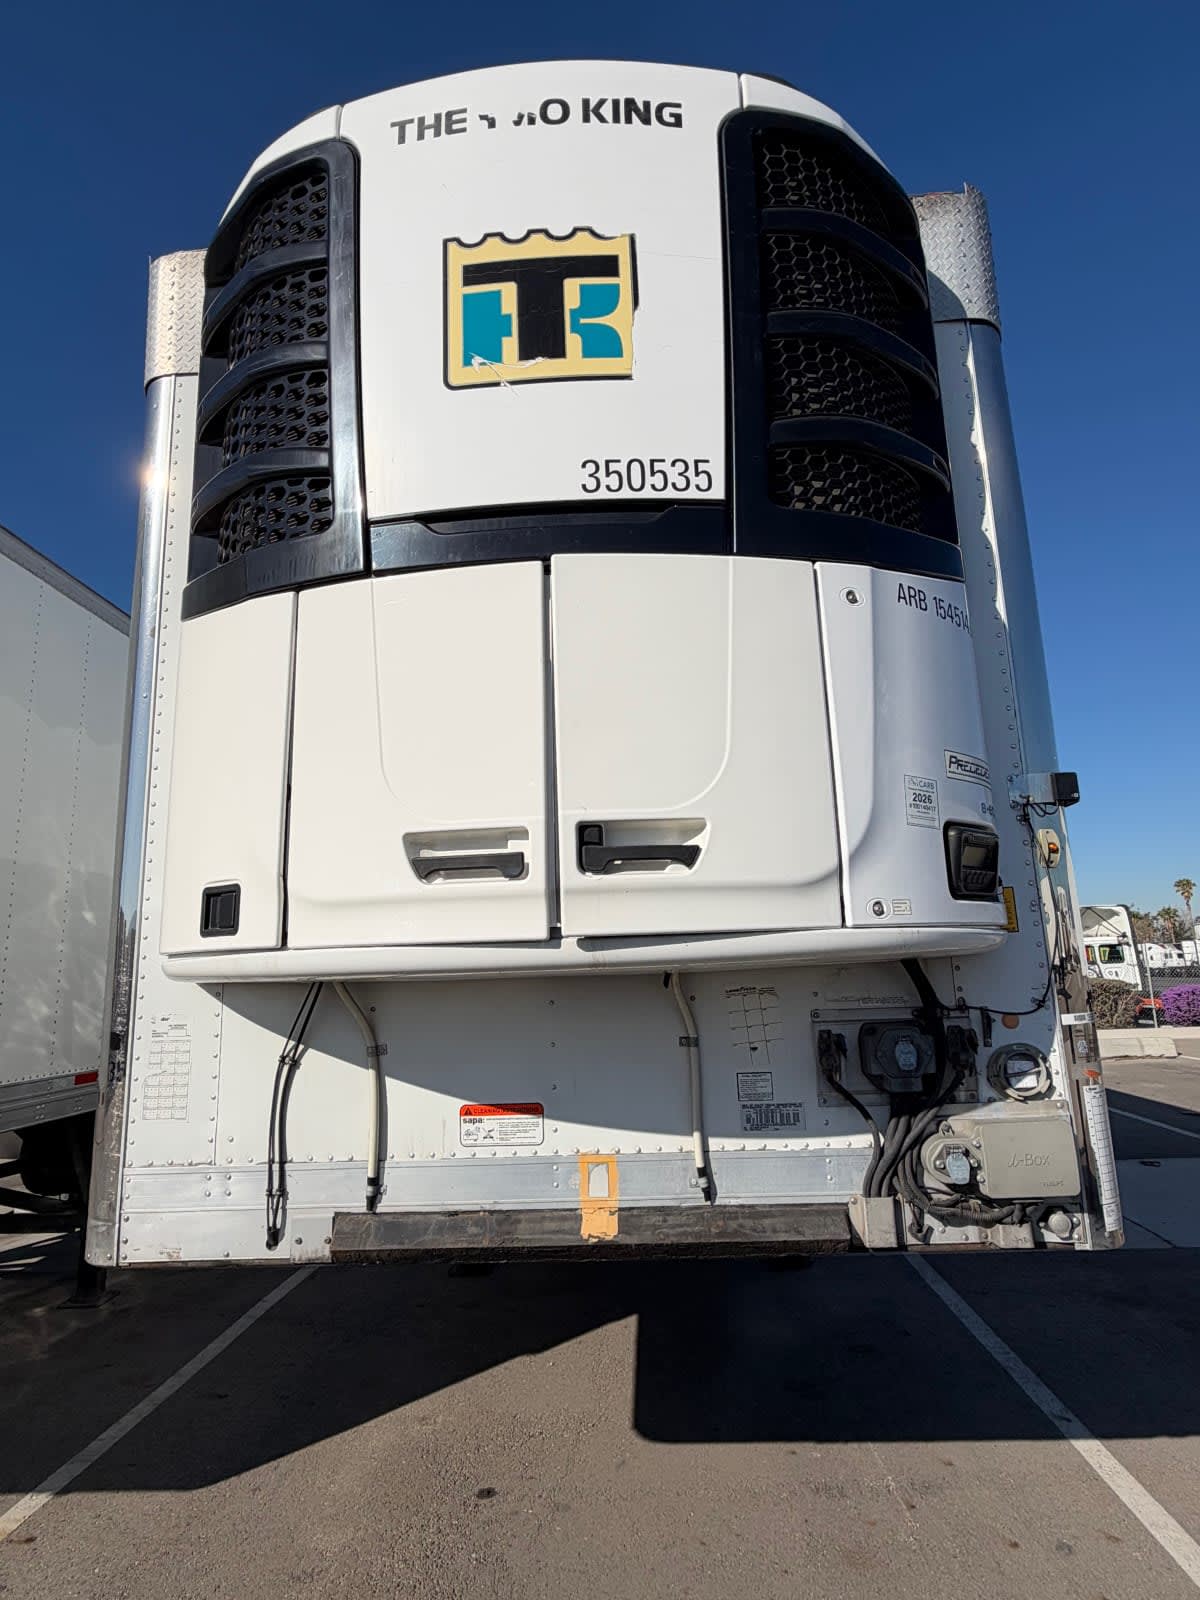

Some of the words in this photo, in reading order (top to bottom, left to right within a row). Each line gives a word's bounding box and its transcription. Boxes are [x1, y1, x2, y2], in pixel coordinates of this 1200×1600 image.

[581, 97, 683, 128] KING
[580, 458, 713, 493] 350535
[897, 583, 928, 611] ARB
[932, 596, 971, 634] 154514
[912, 792, 933, 805] 2026
